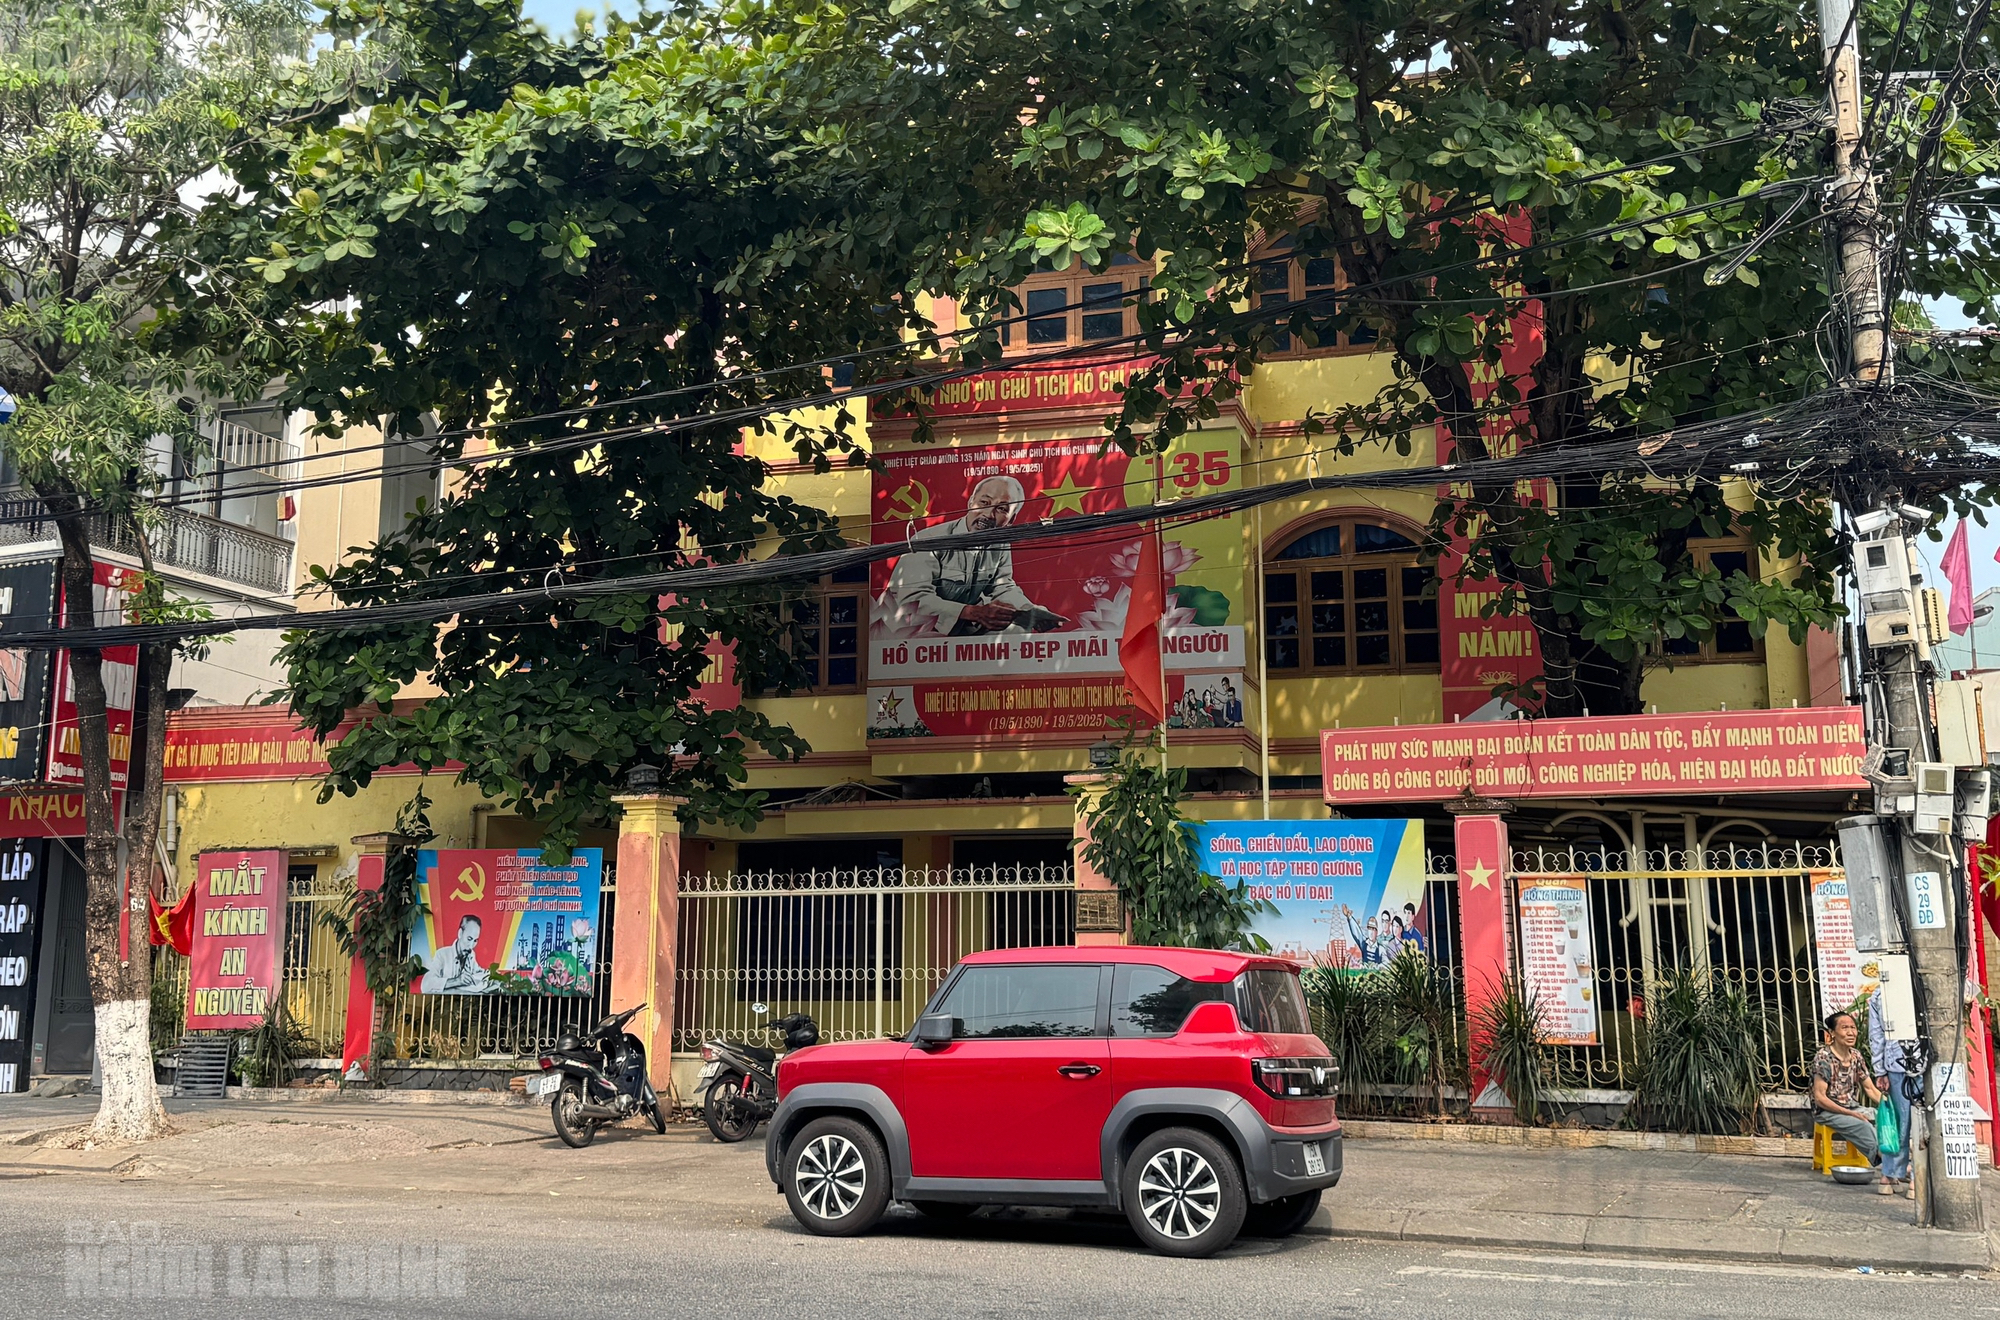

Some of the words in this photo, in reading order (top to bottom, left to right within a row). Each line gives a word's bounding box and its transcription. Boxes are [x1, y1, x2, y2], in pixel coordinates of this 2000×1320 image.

[975, 379, 995, 402] ƠN
[1000, 371, 1031, 400] CHỦ
[1036, 371, 1069, 401] TỊCH
[905, 456, 918, 468] LIỆT
[920, 454, 937, 466] CHÀO
[961, 453, 973, 463] 135
[991, 449, 1010, 461] NGÀY
[1011, 449, 1028, 459] SINH
[1029, 445, 1044, 458] CHỦ
[1045, 446, 1060, 459] TỊCH
[1061, 444, 1071, 456] HỒ
[1072, 444, 1085, 455] CHÍ
[1086, 444, 1102, 455] MIN
[964, 465, 999, 477] (19/5/1890
[1005, 463, 1044, 475] 19/5/2025)!
[1144, 450, 1231, 490] 135
[882, 641, 909, 665] HỒ
[916, 640, 949, 663] CHÍ
[1068, 637, 1109, 658] MÃI
[1160, 629, 1230, 655] NGƯỜI
[1459, 626, 1533, 658] NĂM!
[925, 688, 944, 717] NHIỆT
[945, 687, 959, 717] LIỆT
[960, 687, 979, 711] CHÀO
[980, 686, 1000, 711] MỪNG
[1002, 689, 1014, 710] 135
[1015, 684, 1032, 710] NĂM
[1033, 683, 1052, 709] NGÀY
[1053, 687, 1070, 707] SINH
[1071, 680, 1085, 708] CHỦ
[1086, 685, 1103, 711] TỊCH
[1104, 678, 1113, 707] HỒ
[989, 715, 1043, 731] (19/5/1890
[1052, 713, 1107, 729] 19/5/2025)
[1334, 740, 1367, 762] PHÁT
[1371, 742, 1397, 760] HUY
[1401, 737, 1428, 759] SỨC
[1432, 738, 1473, 761] MẠNH
[1477, 737, 1500, 760] ĐẠI
[1504, 732, 1542, 756] ĐOÀN
[1547, 728, 1572, 753] KẾT
[1577, 726, 1615, 751] TOÀN
[1619, 727, 1651, 750] DÂN
[1655, 726, 1688, 753] TỘC,
[1691, 721, 1721, 748] ĐẨY
[1726, 727, 1772, 750] MẠNH
[1776, 721, 1819, 746] TOÀN
[1823, 720, 1865, 747] DIỆN,
[176, 739, 188, 767] CẢ
[190, 741, 200, 766] VÌ
[199, 744, 220, 771] MỤC
[221, 741, 239, 766] TIÊU
[240, 741, 260, 765] DÂN
[260, 739, 284, 767] GIÀU,
[285, 738, 310, 764] NƯỚC
[1333, 767, 1369, 791] ĐỒNG
[1372, 768, 1391, 793] BỘ
[1394, 768, 1431, 789] CÔNG
[1435, 765, 1472, 791] CUỘC
[1475, 761, 1499, 786] ĐỔI
[1503, 764, 1535, 786] MỚI,
[1539, 761, 1578, 785] CÔNG
[1583, 759, 1637, 785] NGHIỆP
[1640, 759, 1676, 782] HÓA,
[1680, 757, 1716, 783] HIỆN
[1719, 759, 1746, 782] ĐẠI
[1750, 755, 1783, 778] HÓA
[1785, 751, 1816, 777] ĐẤT
[1820, 753, 1863, 777] NƯỚC
[1211, 832, 1245, 853] SỐNG,
[1247, 832, 1283, 852] CHIẾN
[1285, 832, 1312, 853] ĐẤU,
[1315, 836, 1336, 852] LAO
[1340, 834, 1374, 855] ĐỘNG
[1, 838, 35, 881] LẮP
[516, 856, 535, 869] ĐỊNH
[1221, 859, 1236, 876] VÀ
[1239, 861, 1261, 879] HỌC
[1265, 860, 1286, 879] TẬP
[1289, 861, 1318, 876] THEO
[1322, 859, 1363, 876] GƯƠNG
[209, 858, 267, 897] MẮT
[496, 870, 516, 882] PHÁT
[540, 869, 562, 881] SÁNG
[563, 871, 579, 884] TẠO
[1914, 876, 1929, 890] CS
[495, 881, 511, 897] CHỦ
[1249, 882, 1272, 900] BÁC
[1276, 881, 1292, 900] HỒ
[1295, 882, 1306, 900] VĨ
[1309, 884, 1333, 903] ĐẠI!
[1918, 893, 1930, 908] 29
[531, 898, 542, 912] HỒ
[543, 899, 557, 911] CHÍ
[203, 903, 268, 937] KÍNH
[1918, 910, 1934, 924] ĐĐ
[218, 946, 246, 977] AN
[193, 978, 268, 1017] NGUYỄN
[1944, 1100, 1960, 1109] CHO
[1946, 1143, 1961, 1154] ALO
